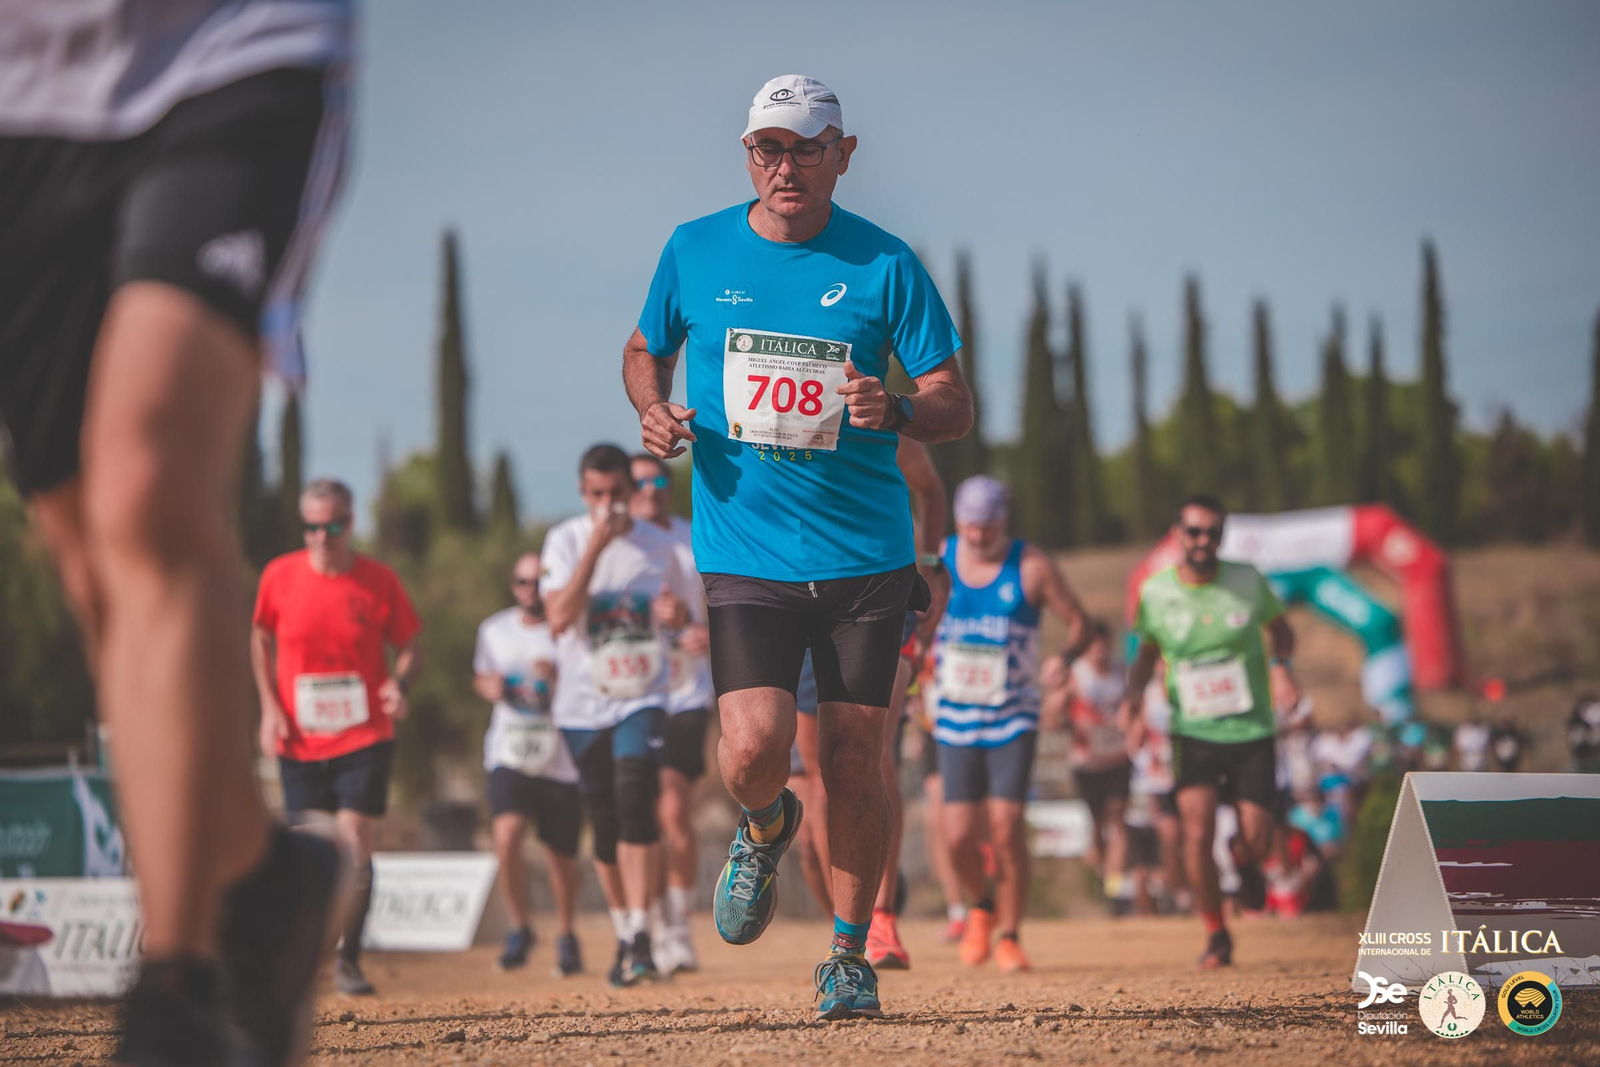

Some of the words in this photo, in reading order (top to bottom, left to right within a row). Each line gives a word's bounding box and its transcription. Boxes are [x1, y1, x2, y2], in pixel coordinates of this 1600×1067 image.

[761, 338, 817, 355] ITÁLICA
[802, 361, 828, 369] PACHECO
[747, 374, 824, 417] 708
